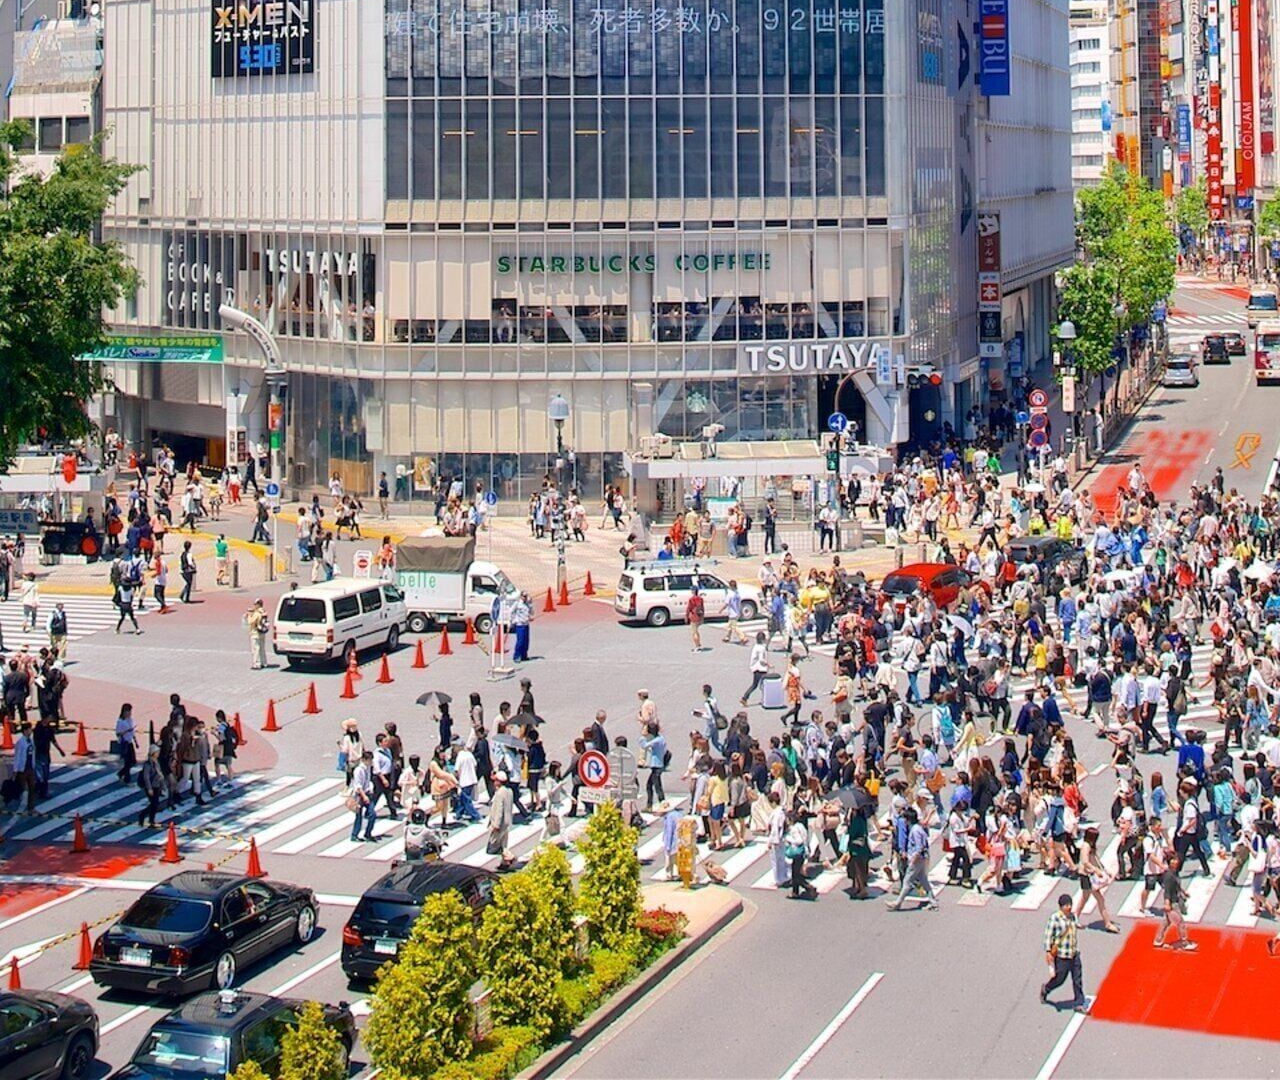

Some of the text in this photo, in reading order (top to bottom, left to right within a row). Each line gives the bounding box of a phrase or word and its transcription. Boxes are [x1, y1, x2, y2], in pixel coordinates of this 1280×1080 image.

[214, 0, 310, 29] X-MEN
[266, 249, 359, 276] TSUTAYA
[497, 252, 771, 275] STARBUCKS COFFEE
[983, 284, 997, 300] 本
[746, 341, 883, 373] TSUTAYA
